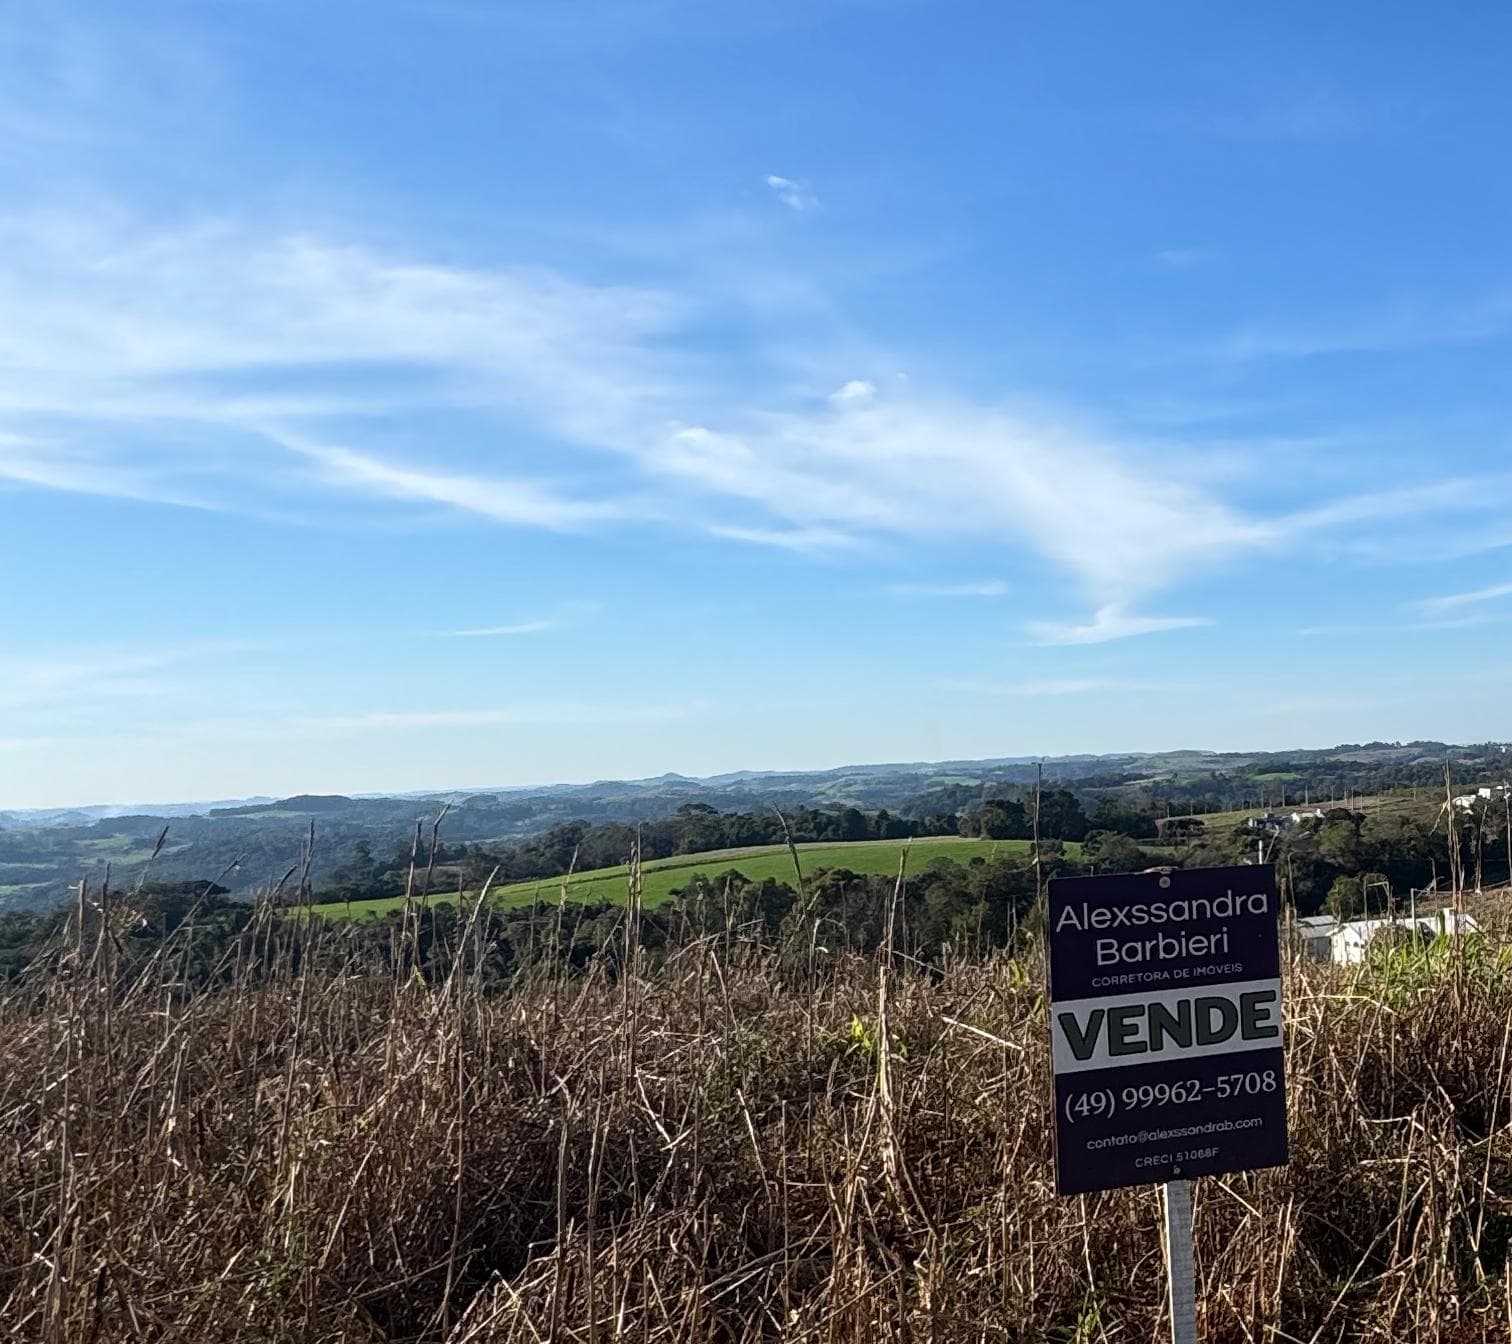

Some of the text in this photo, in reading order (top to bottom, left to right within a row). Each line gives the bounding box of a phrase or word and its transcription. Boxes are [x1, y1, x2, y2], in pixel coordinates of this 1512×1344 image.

[1056, 889, 1268, 933] Alexssandra
[1096, 926, 1229, 966] Barbieri
[1092, 962, 1243, 987] CORRETORA DE IMÓVEIS
[1057, 990, 1279, 1061] VENDE
[1065, 1070, 1277, 1123] (49) 99962-5708
[1135, 1153, 1174, 1168] CRECI
